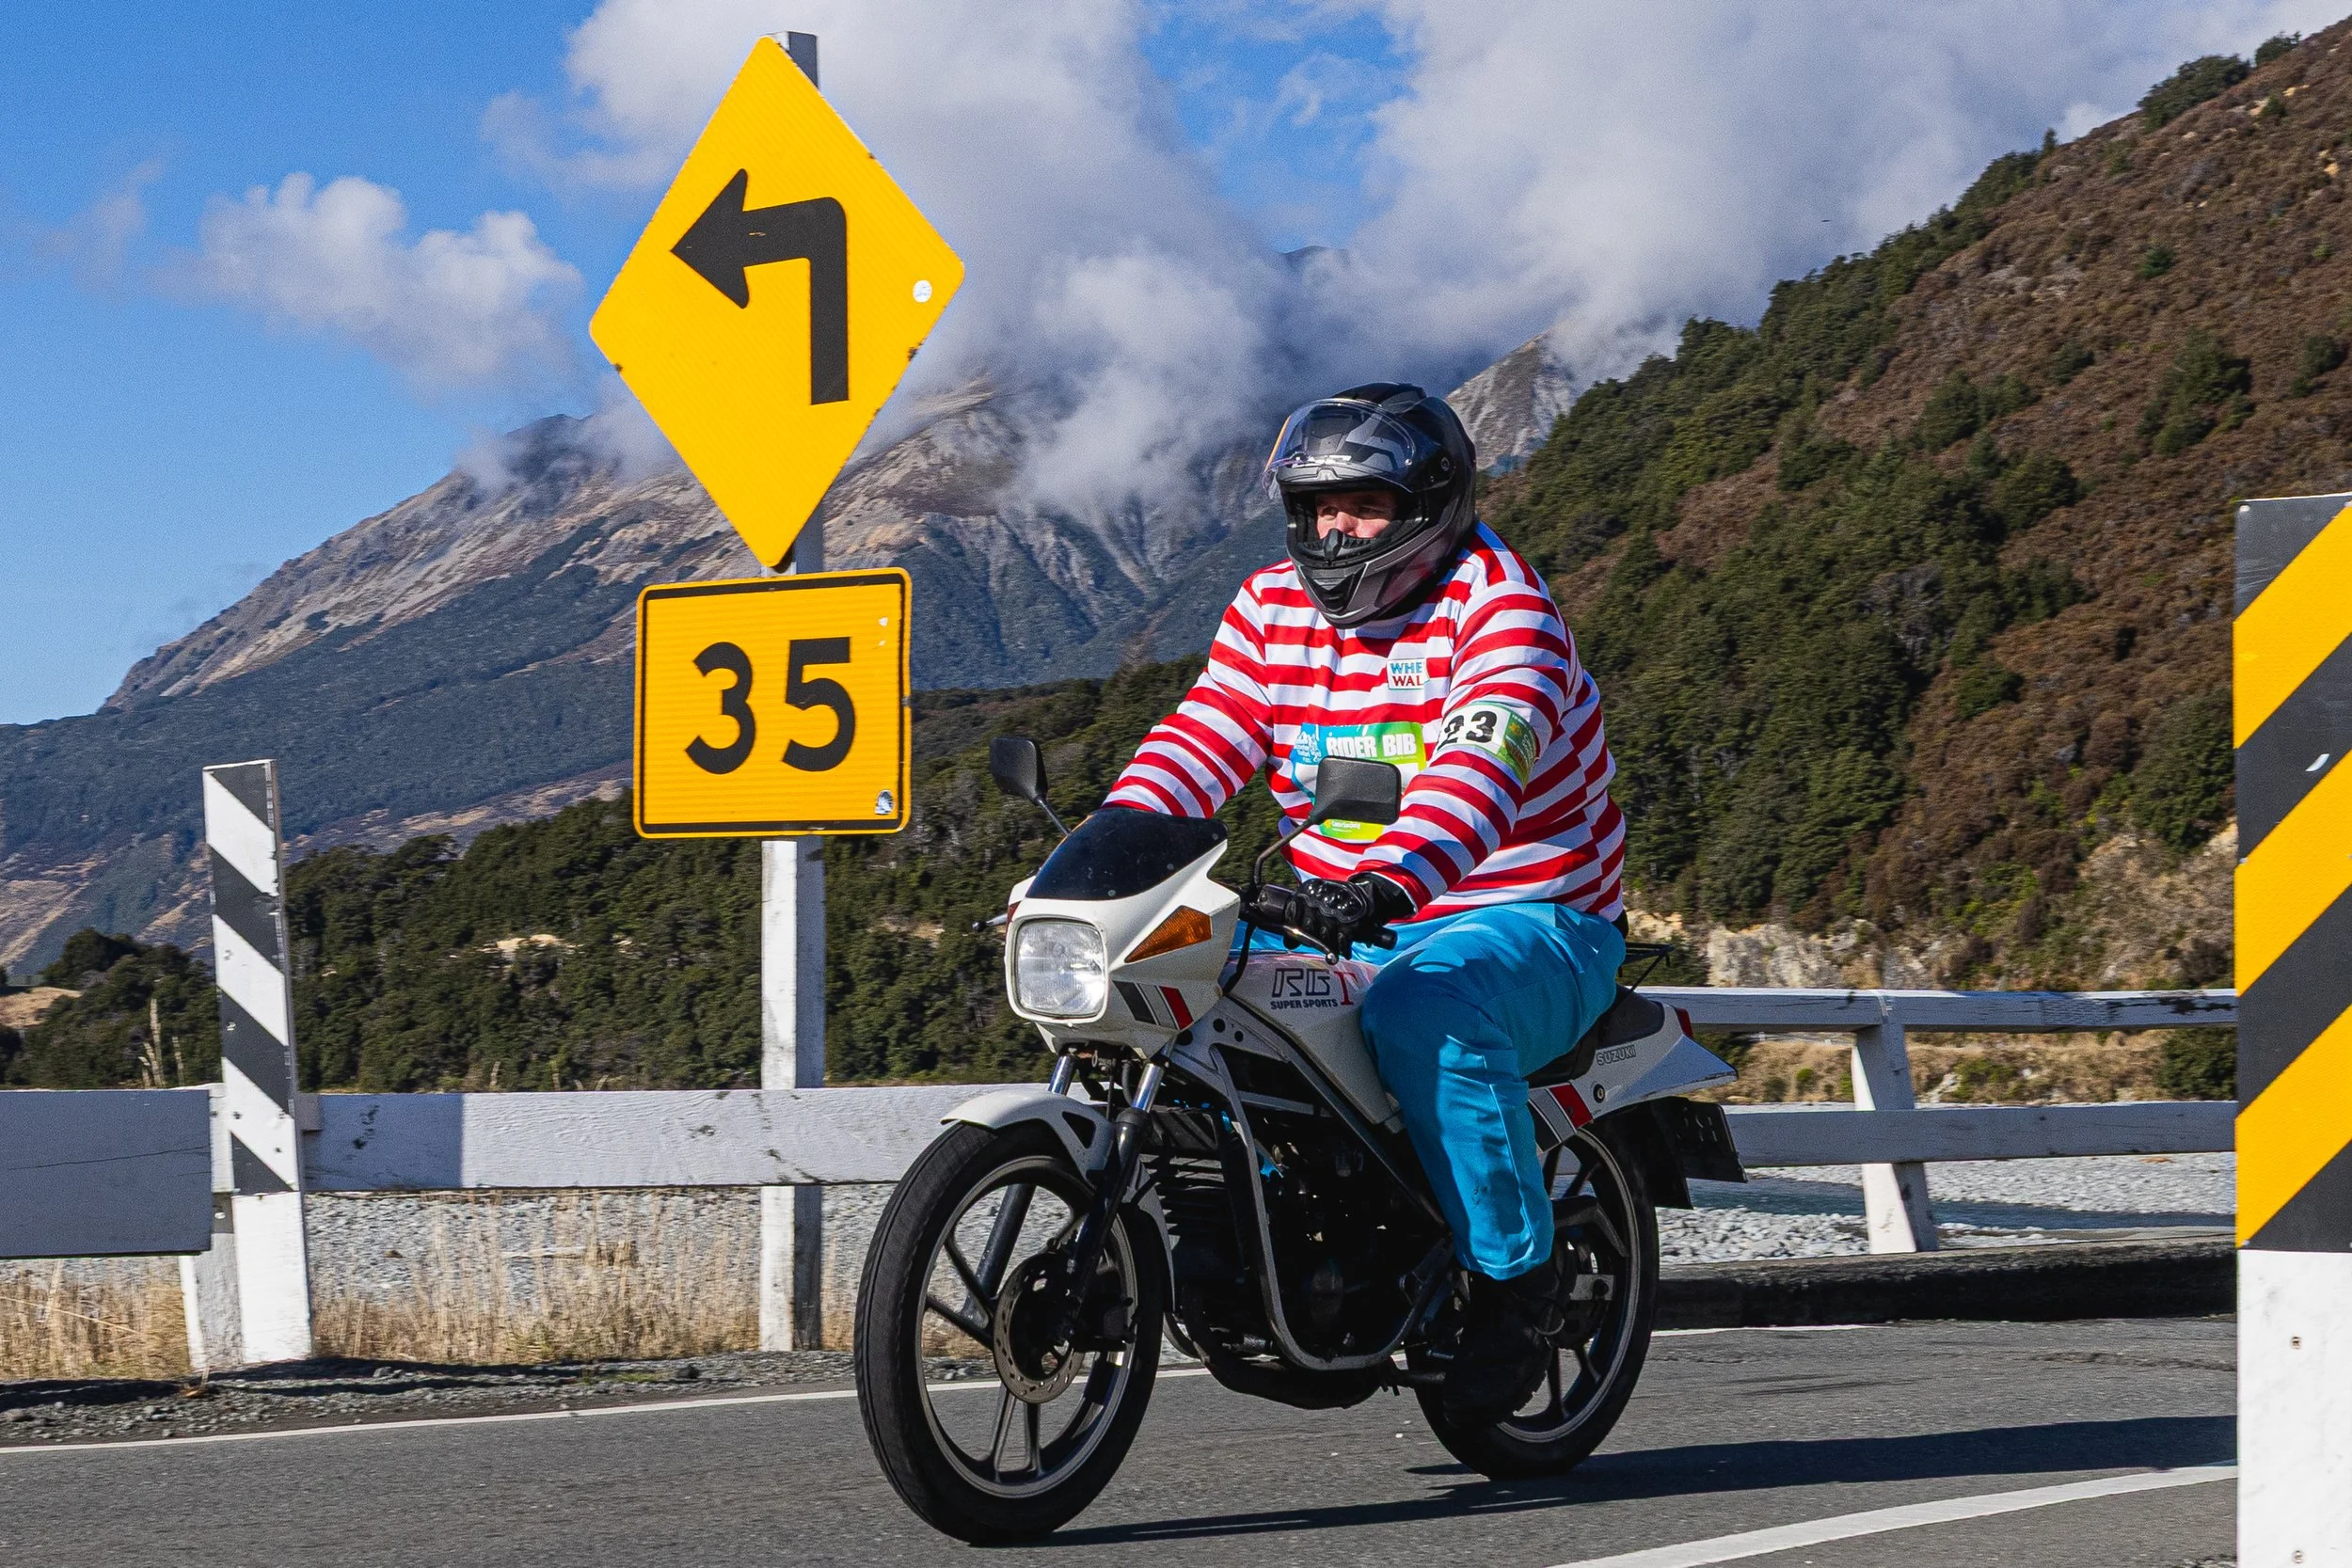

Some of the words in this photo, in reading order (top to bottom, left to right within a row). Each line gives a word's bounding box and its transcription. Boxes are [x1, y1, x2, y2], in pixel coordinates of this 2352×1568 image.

[685, 637, 856, 775] 35
[1437, 710, 1498, 752] 23
[1327, 736, 1377, 758] RIDER
[1382, 733, 1417, 757] BIB
[1270, 1000, 1302, 1010] SUPER
[1303, 998, 1338, 1009] SPORTS
[1597, 1045, 1637, 1065] SUZUKI
